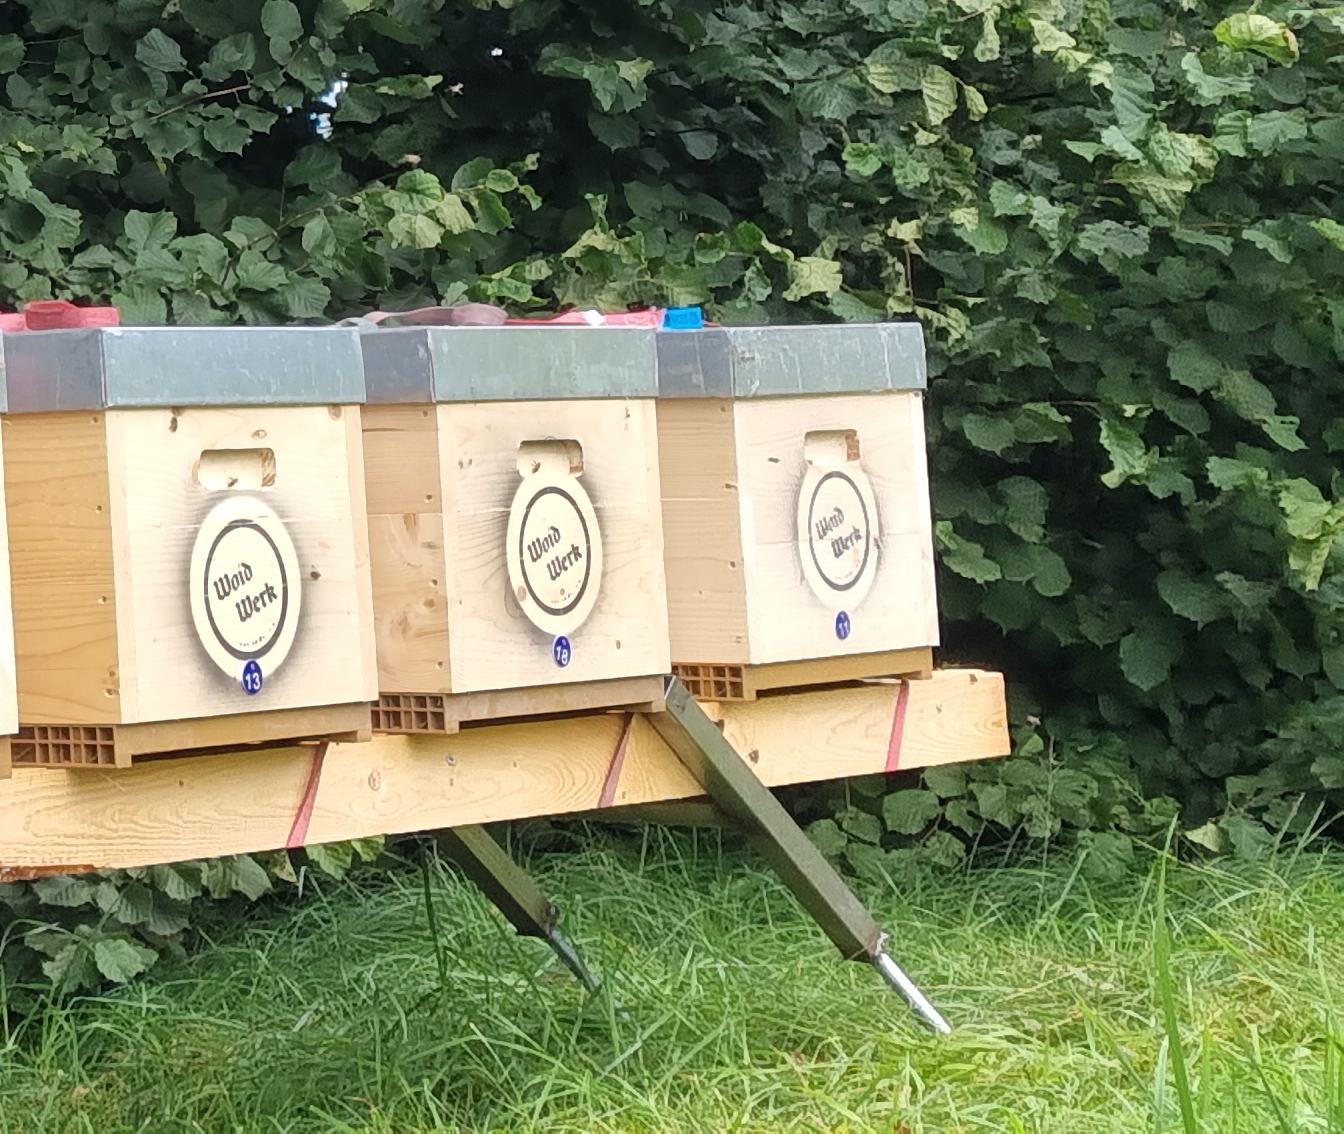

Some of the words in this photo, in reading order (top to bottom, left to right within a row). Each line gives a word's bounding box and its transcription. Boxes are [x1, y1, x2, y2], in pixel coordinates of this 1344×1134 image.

[527, 525, 561, 563] Woid
[831, 525, 862, 559] Werk
[213, 562, 253, 600] Woid
[546, 543, 583, 581] Werk
[235, 582, 278, 622] Werk
[556, 645, 569, 665] 18
[245, 672, 261, 690] 13
